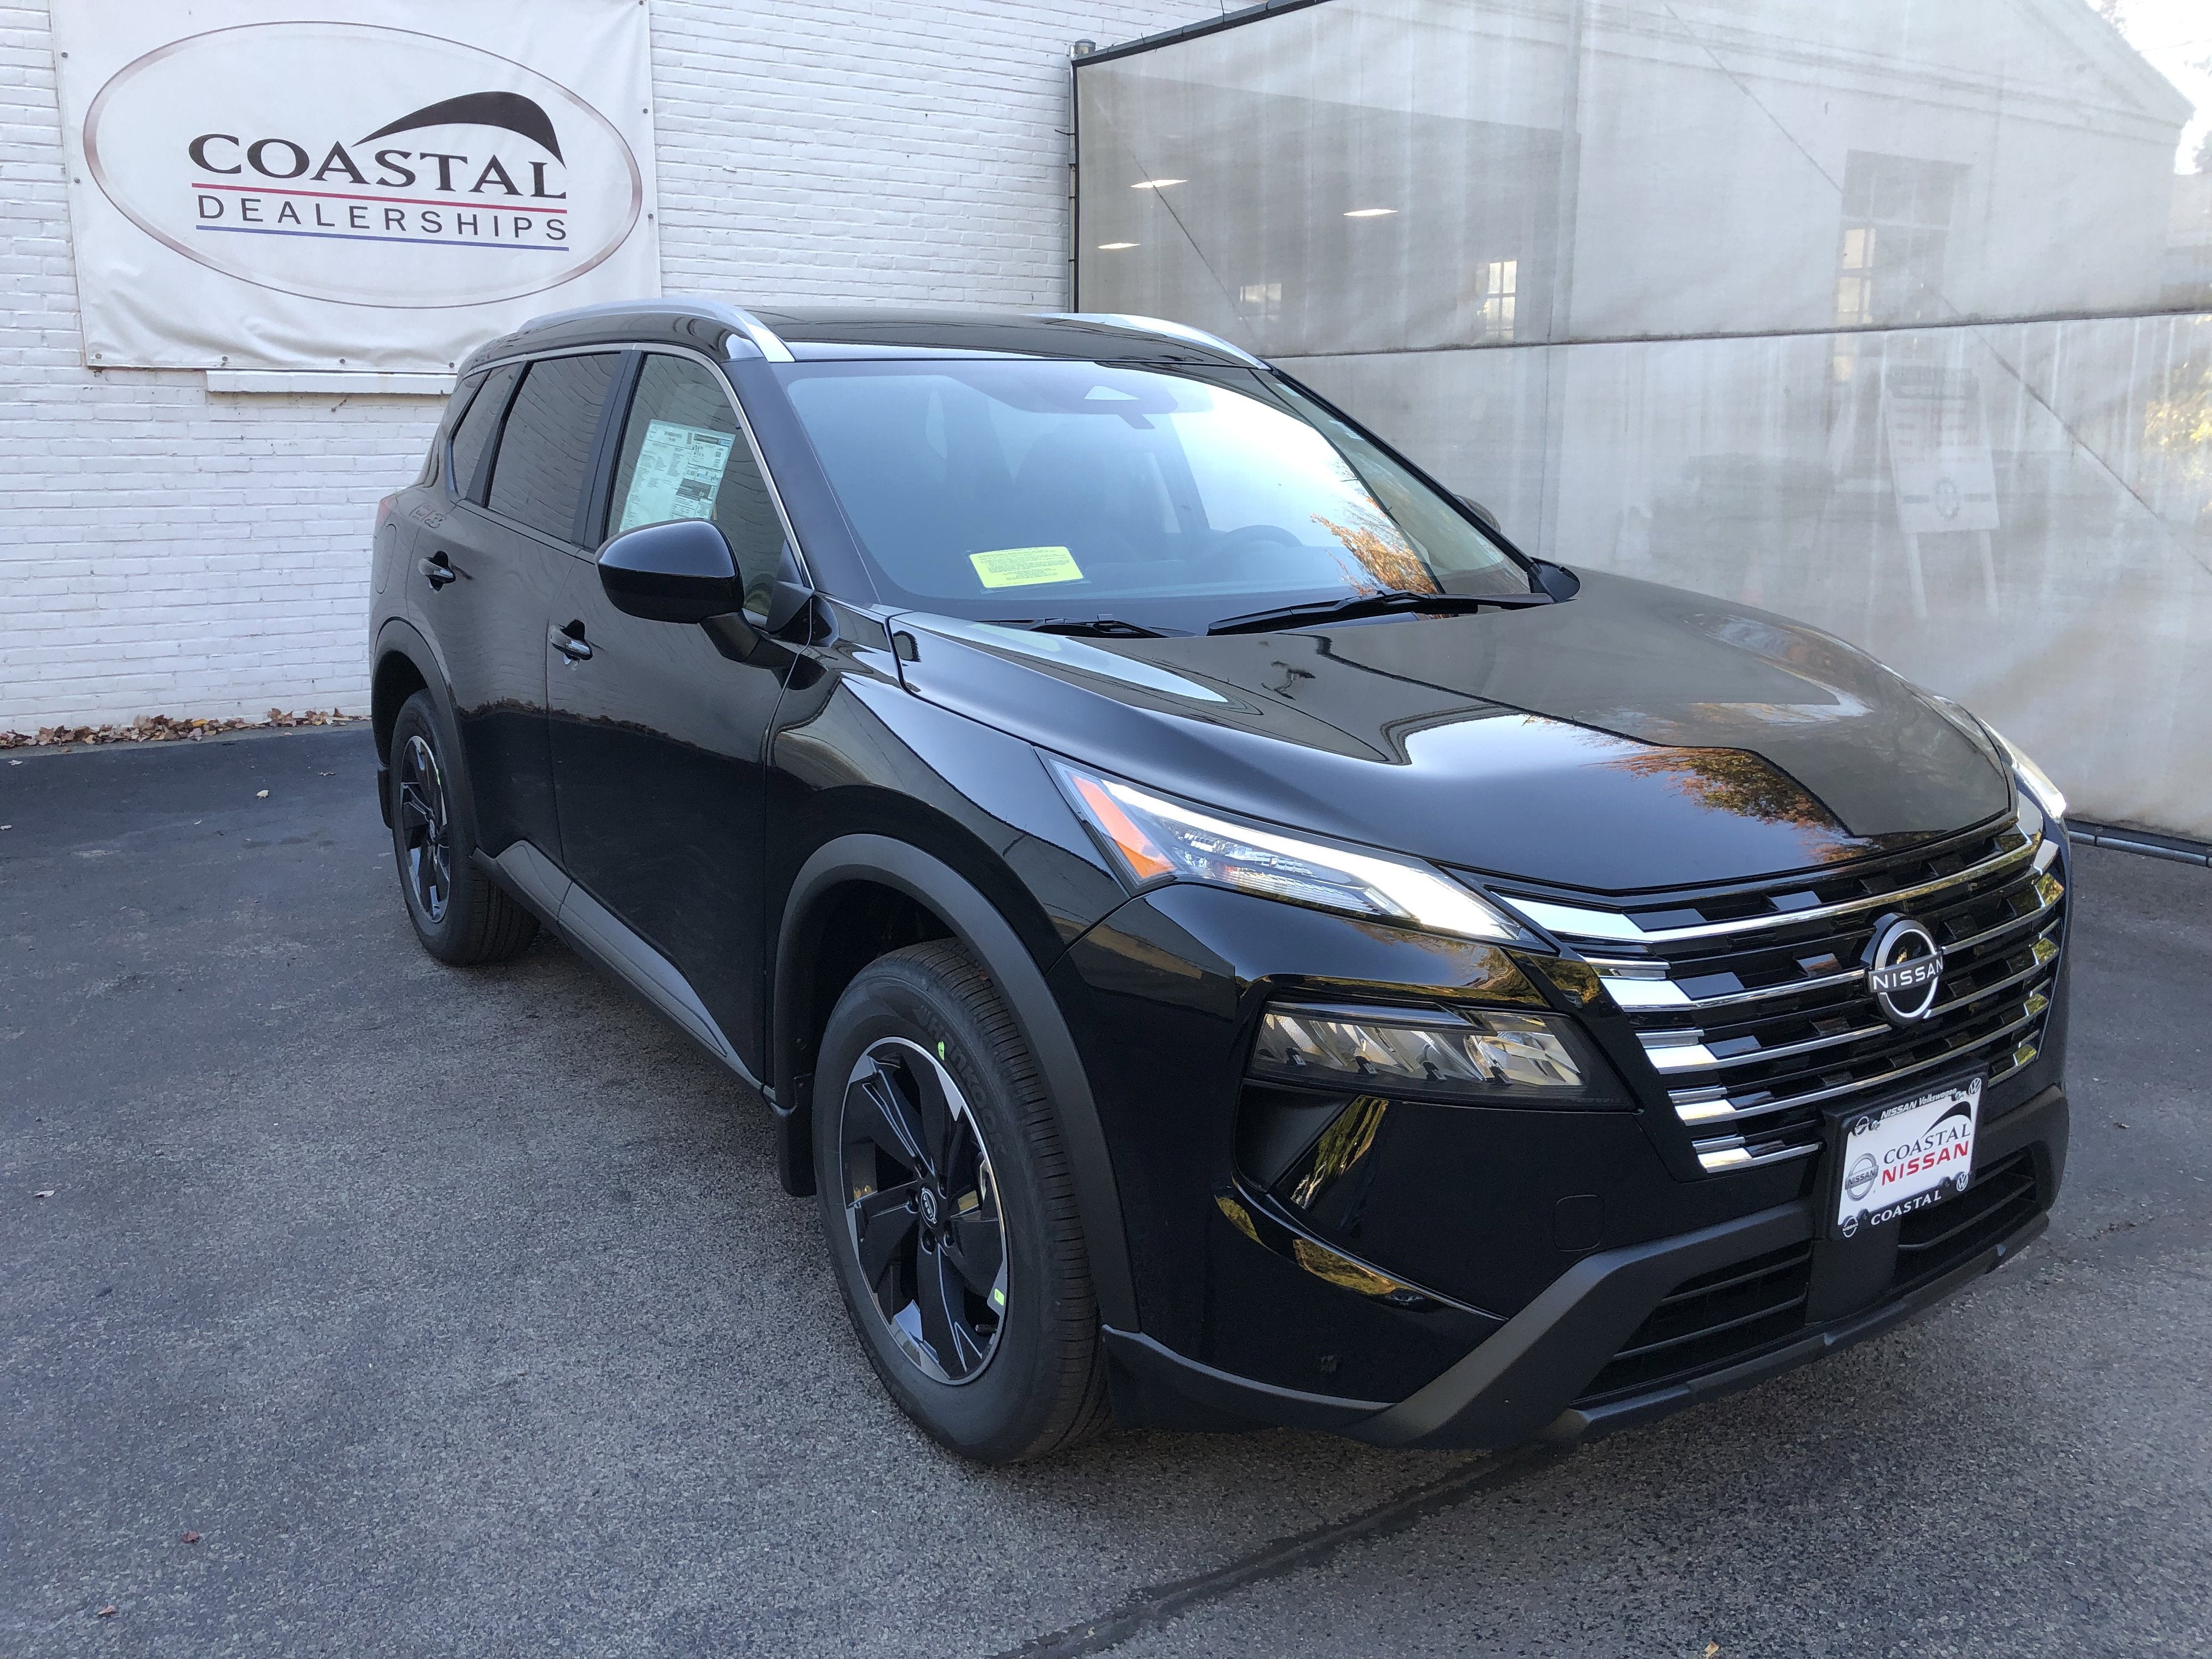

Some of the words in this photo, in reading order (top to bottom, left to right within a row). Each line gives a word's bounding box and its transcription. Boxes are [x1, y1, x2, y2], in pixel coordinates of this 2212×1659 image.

[188, 133, 567, 200] COASTAL
[197, 195, 567, 241] DEALERSHIPS
[1873, 956, 1943, 990] NISSAN
[1880, 1100, 1917, 1119] NISSAN
[1883, 1124, 1971, 1164] COASTAL
[1847, 1168, 1876, 1185] NISSAN
[1881, 1141, 1970, 1186] NISSAN
[1871, 1190, 1942, 1226] COASTAL
